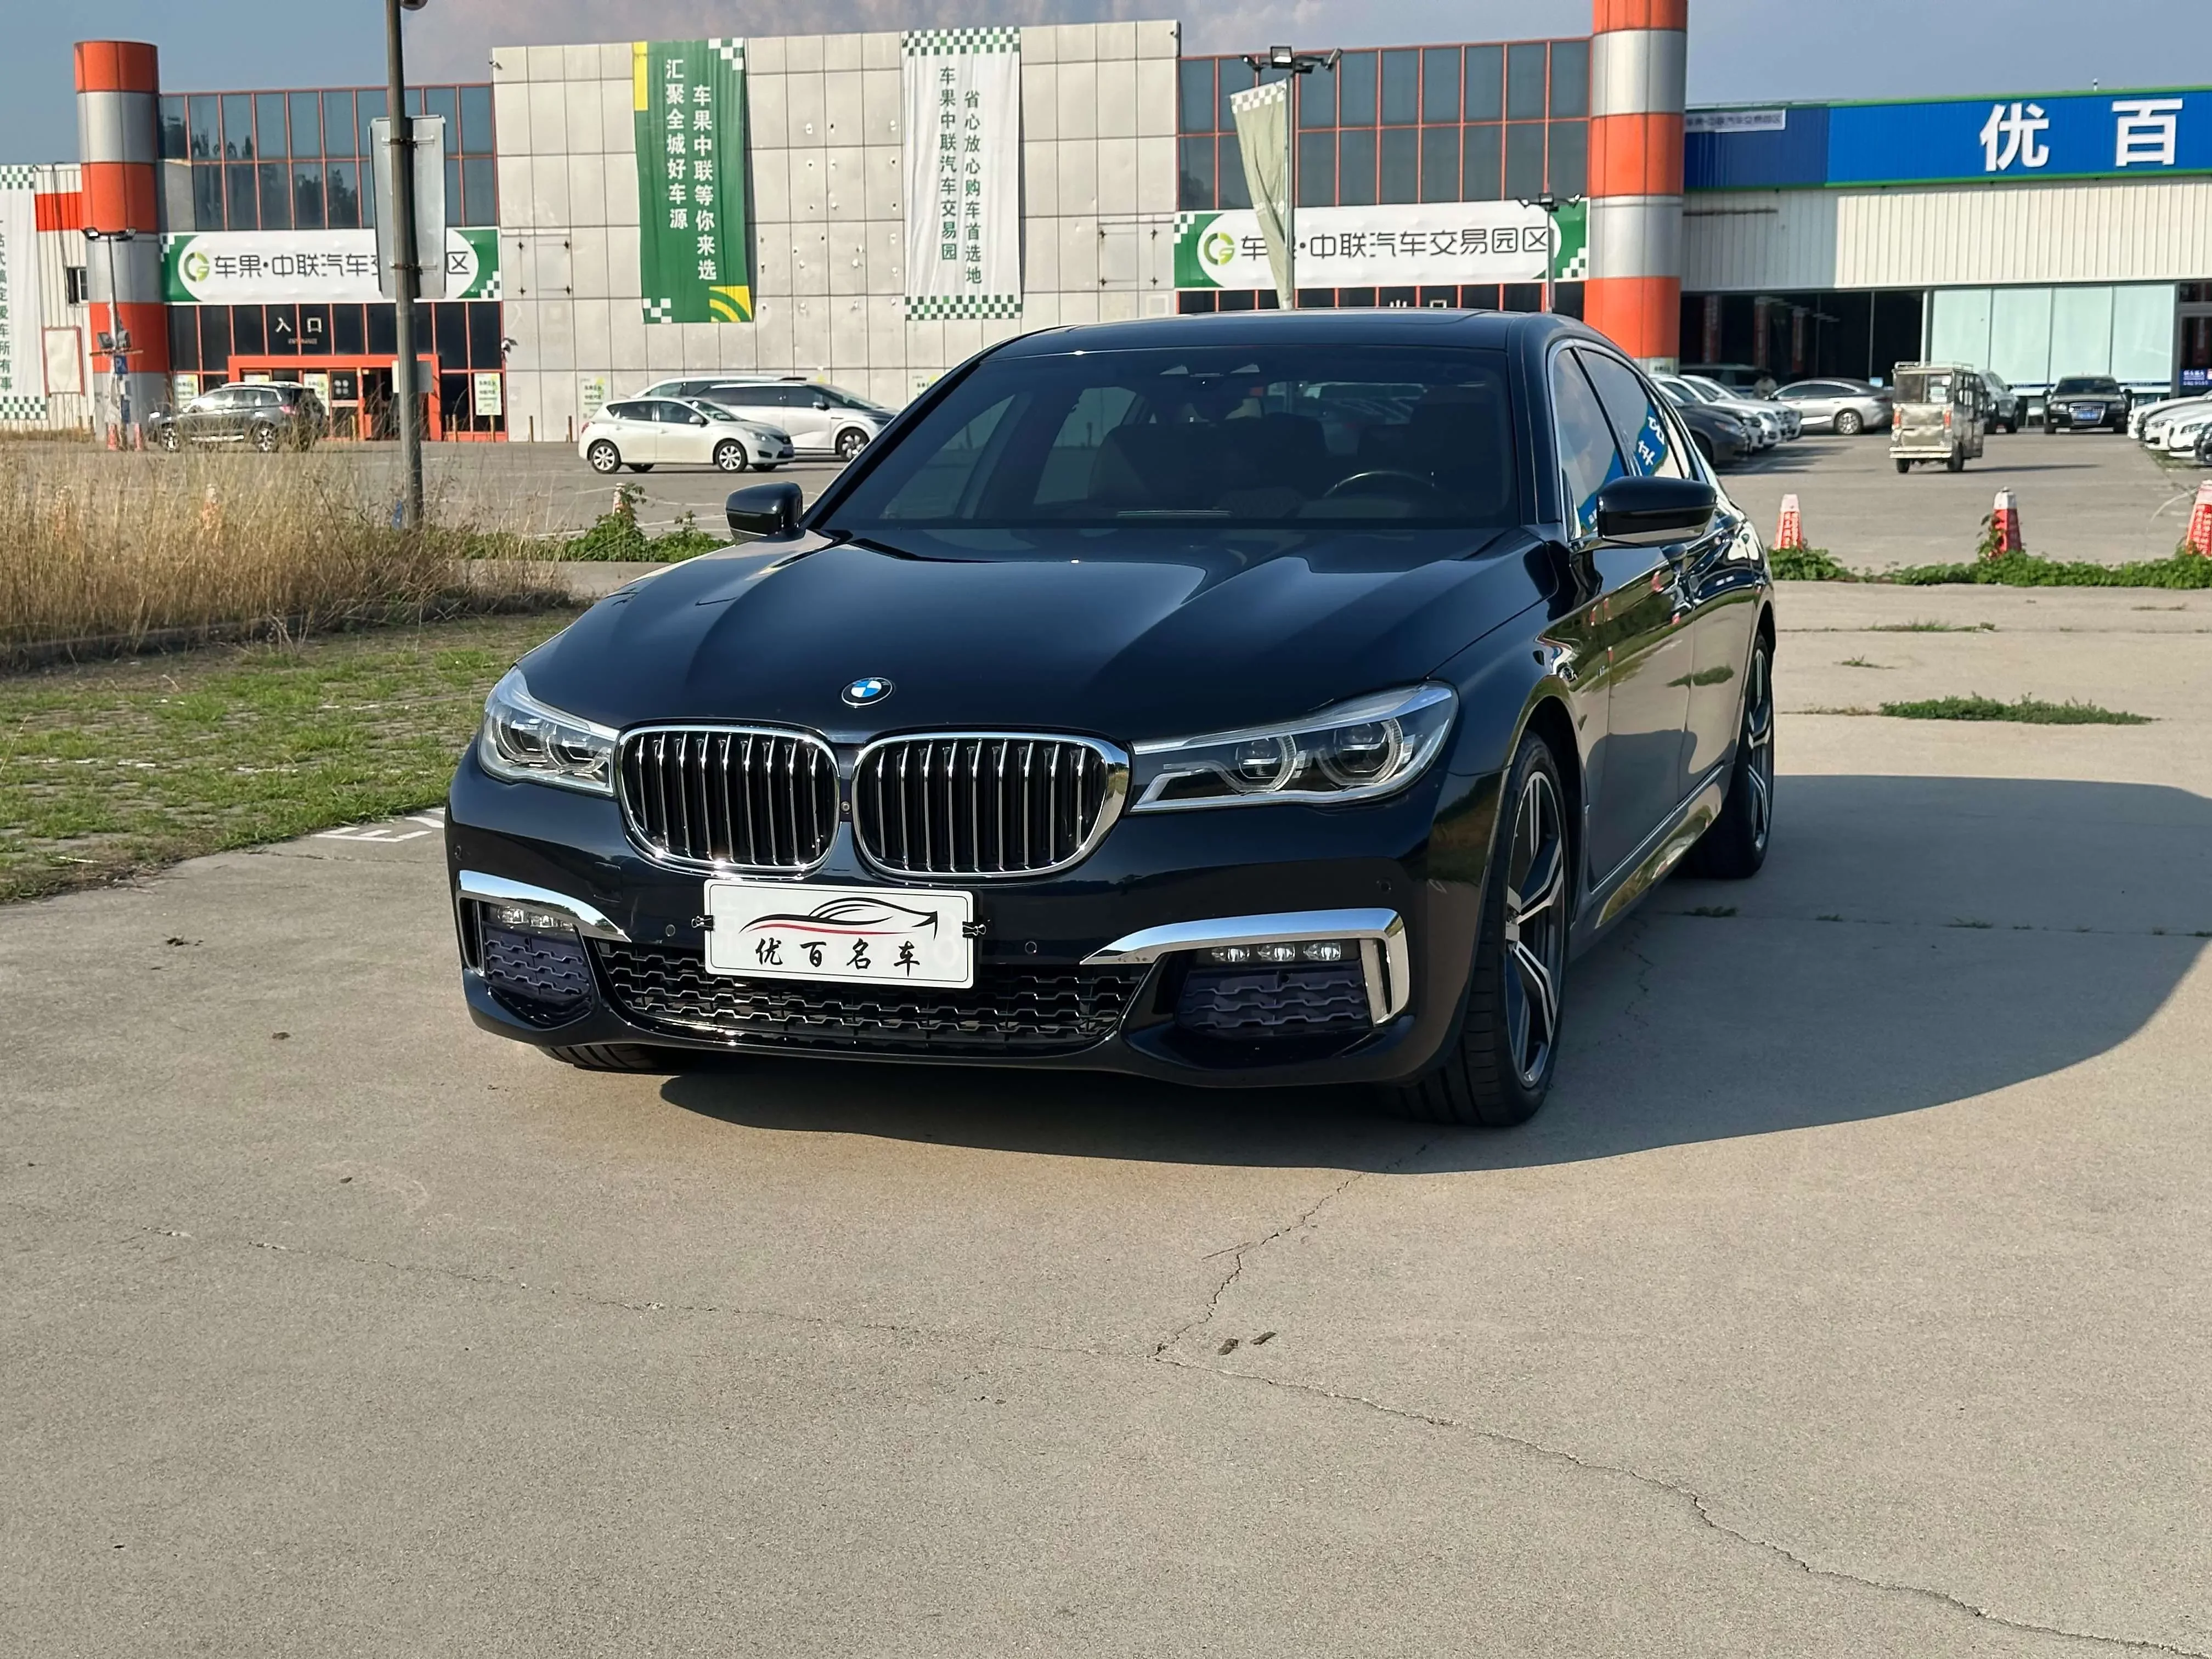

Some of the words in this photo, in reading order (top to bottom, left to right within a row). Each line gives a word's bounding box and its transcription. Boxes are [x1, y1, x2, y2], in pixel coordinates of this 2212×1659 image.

[665, 59, 688, 229] 汇聚全城好车源
[939, 66, 957, 260] 车果中联汽车交易园
[1979, 98, 2183, 172] 优百
[692, 84, 717, 280] 车果中联等你来选
[964, 90, 982, 284] 省心放心购车首选地
[215, 251, 470, 278] 车果·中联汽车区
[1241, 226, 1548, 261] 车·中联汽车交易园区
[275, 317, 322, 333] 入口
[755, 937, 921, 978] 优百名车
